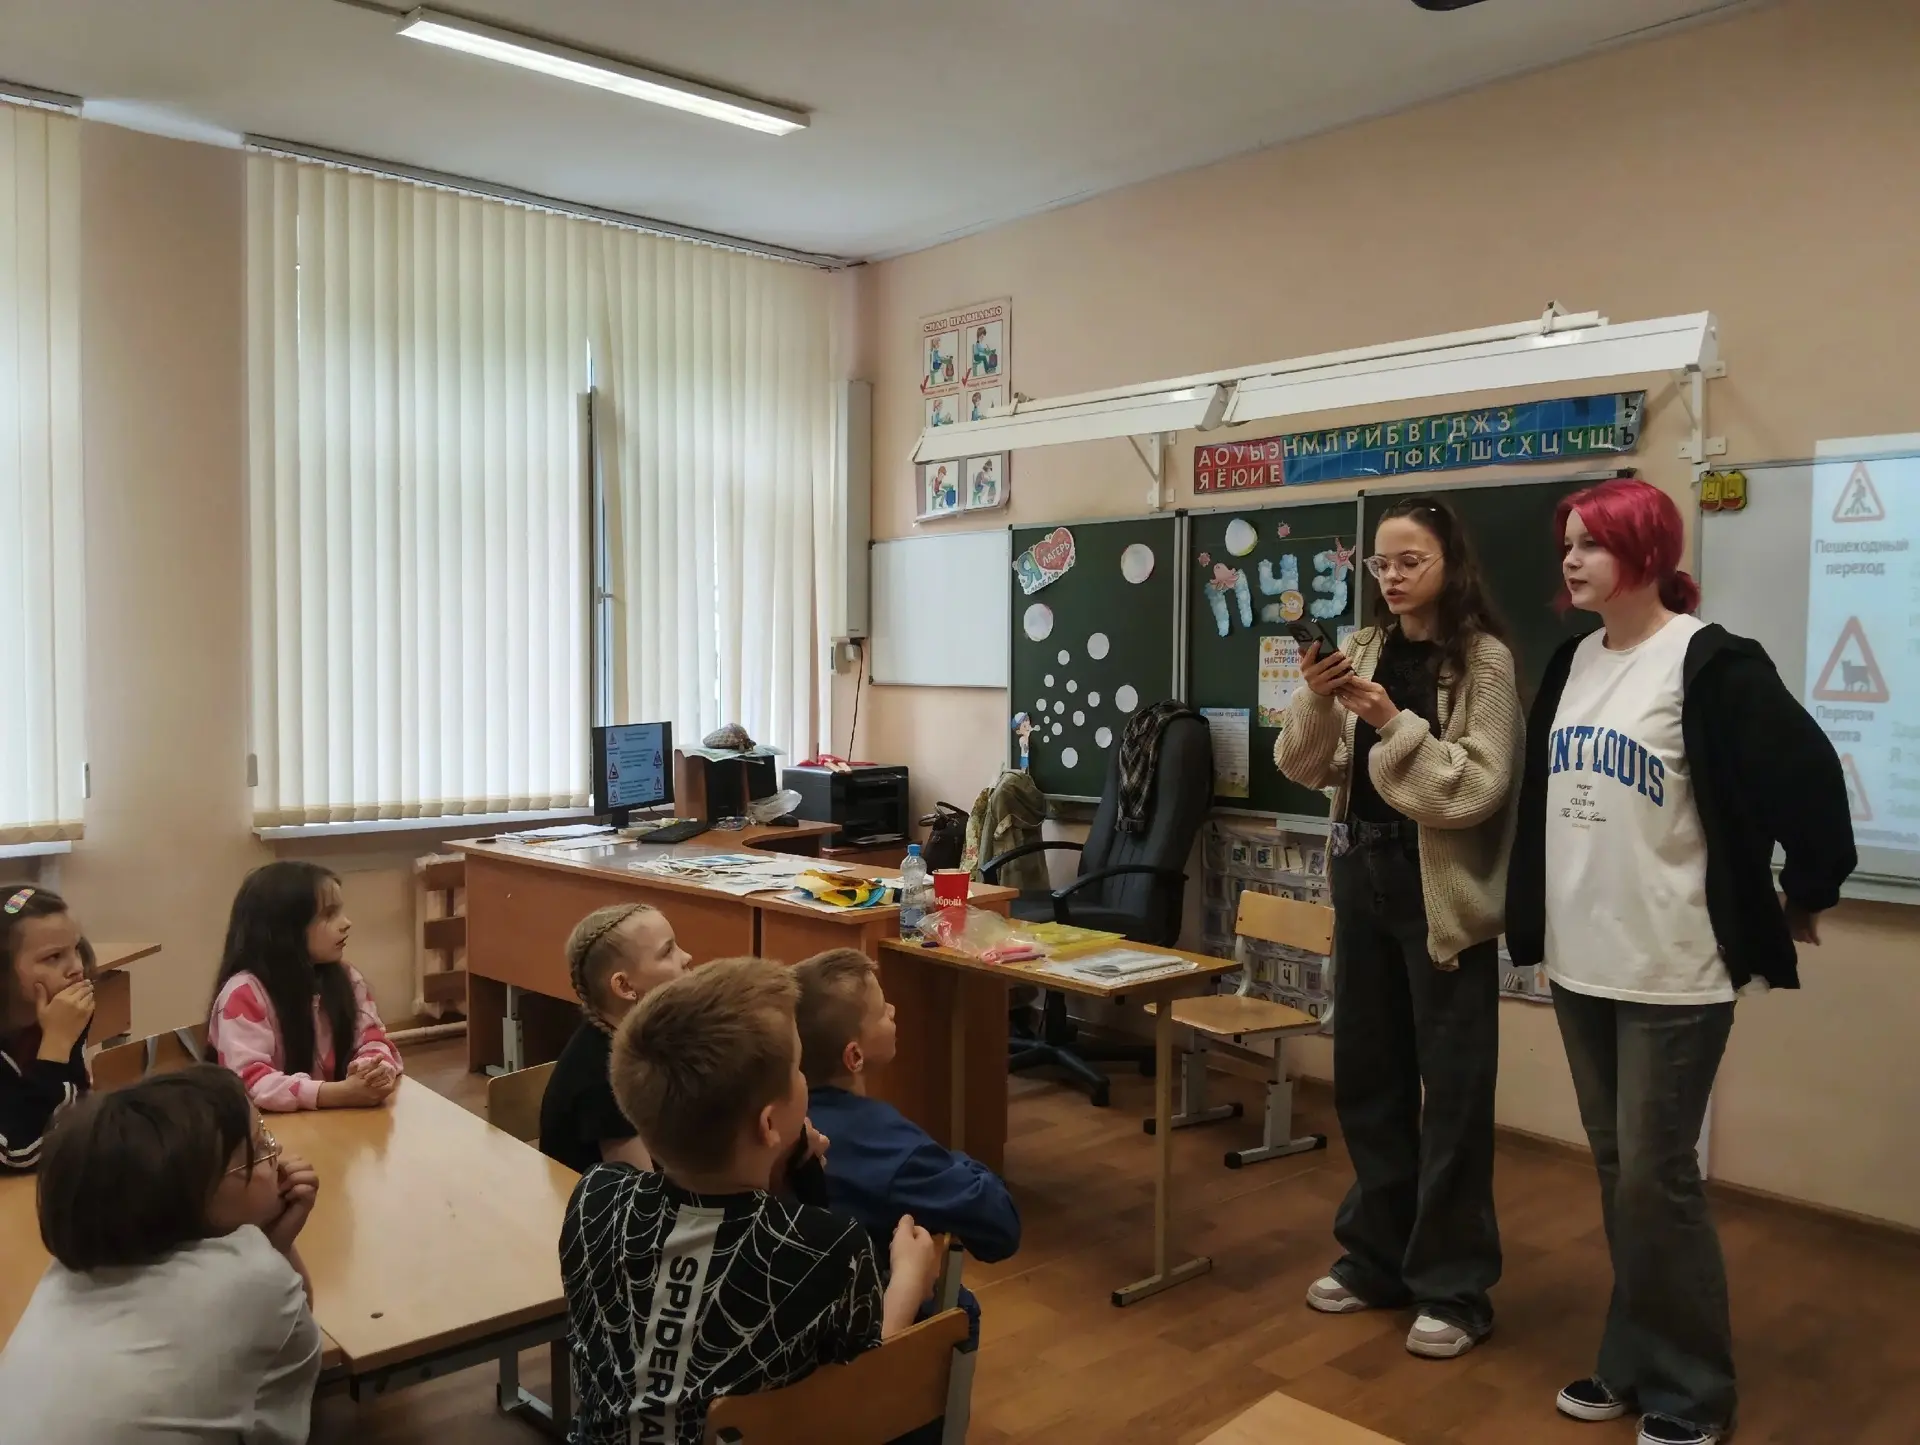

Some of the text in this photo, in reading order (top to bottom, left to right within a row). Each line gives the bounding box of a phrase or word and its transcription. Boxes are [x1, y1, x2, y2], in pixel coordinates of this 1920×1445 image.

[949, 306, 1002, 326] ПРАВИЛЬНО
[1042, 541, 1070, 566] ЛАГЕРЬ
[1017, 551, 1042, 589] Я
[1825, 562, 1885, 578] переход
[1274, 648, 1297, 656] ЭКРАН
[1824, 730, 1861, 742] кота
